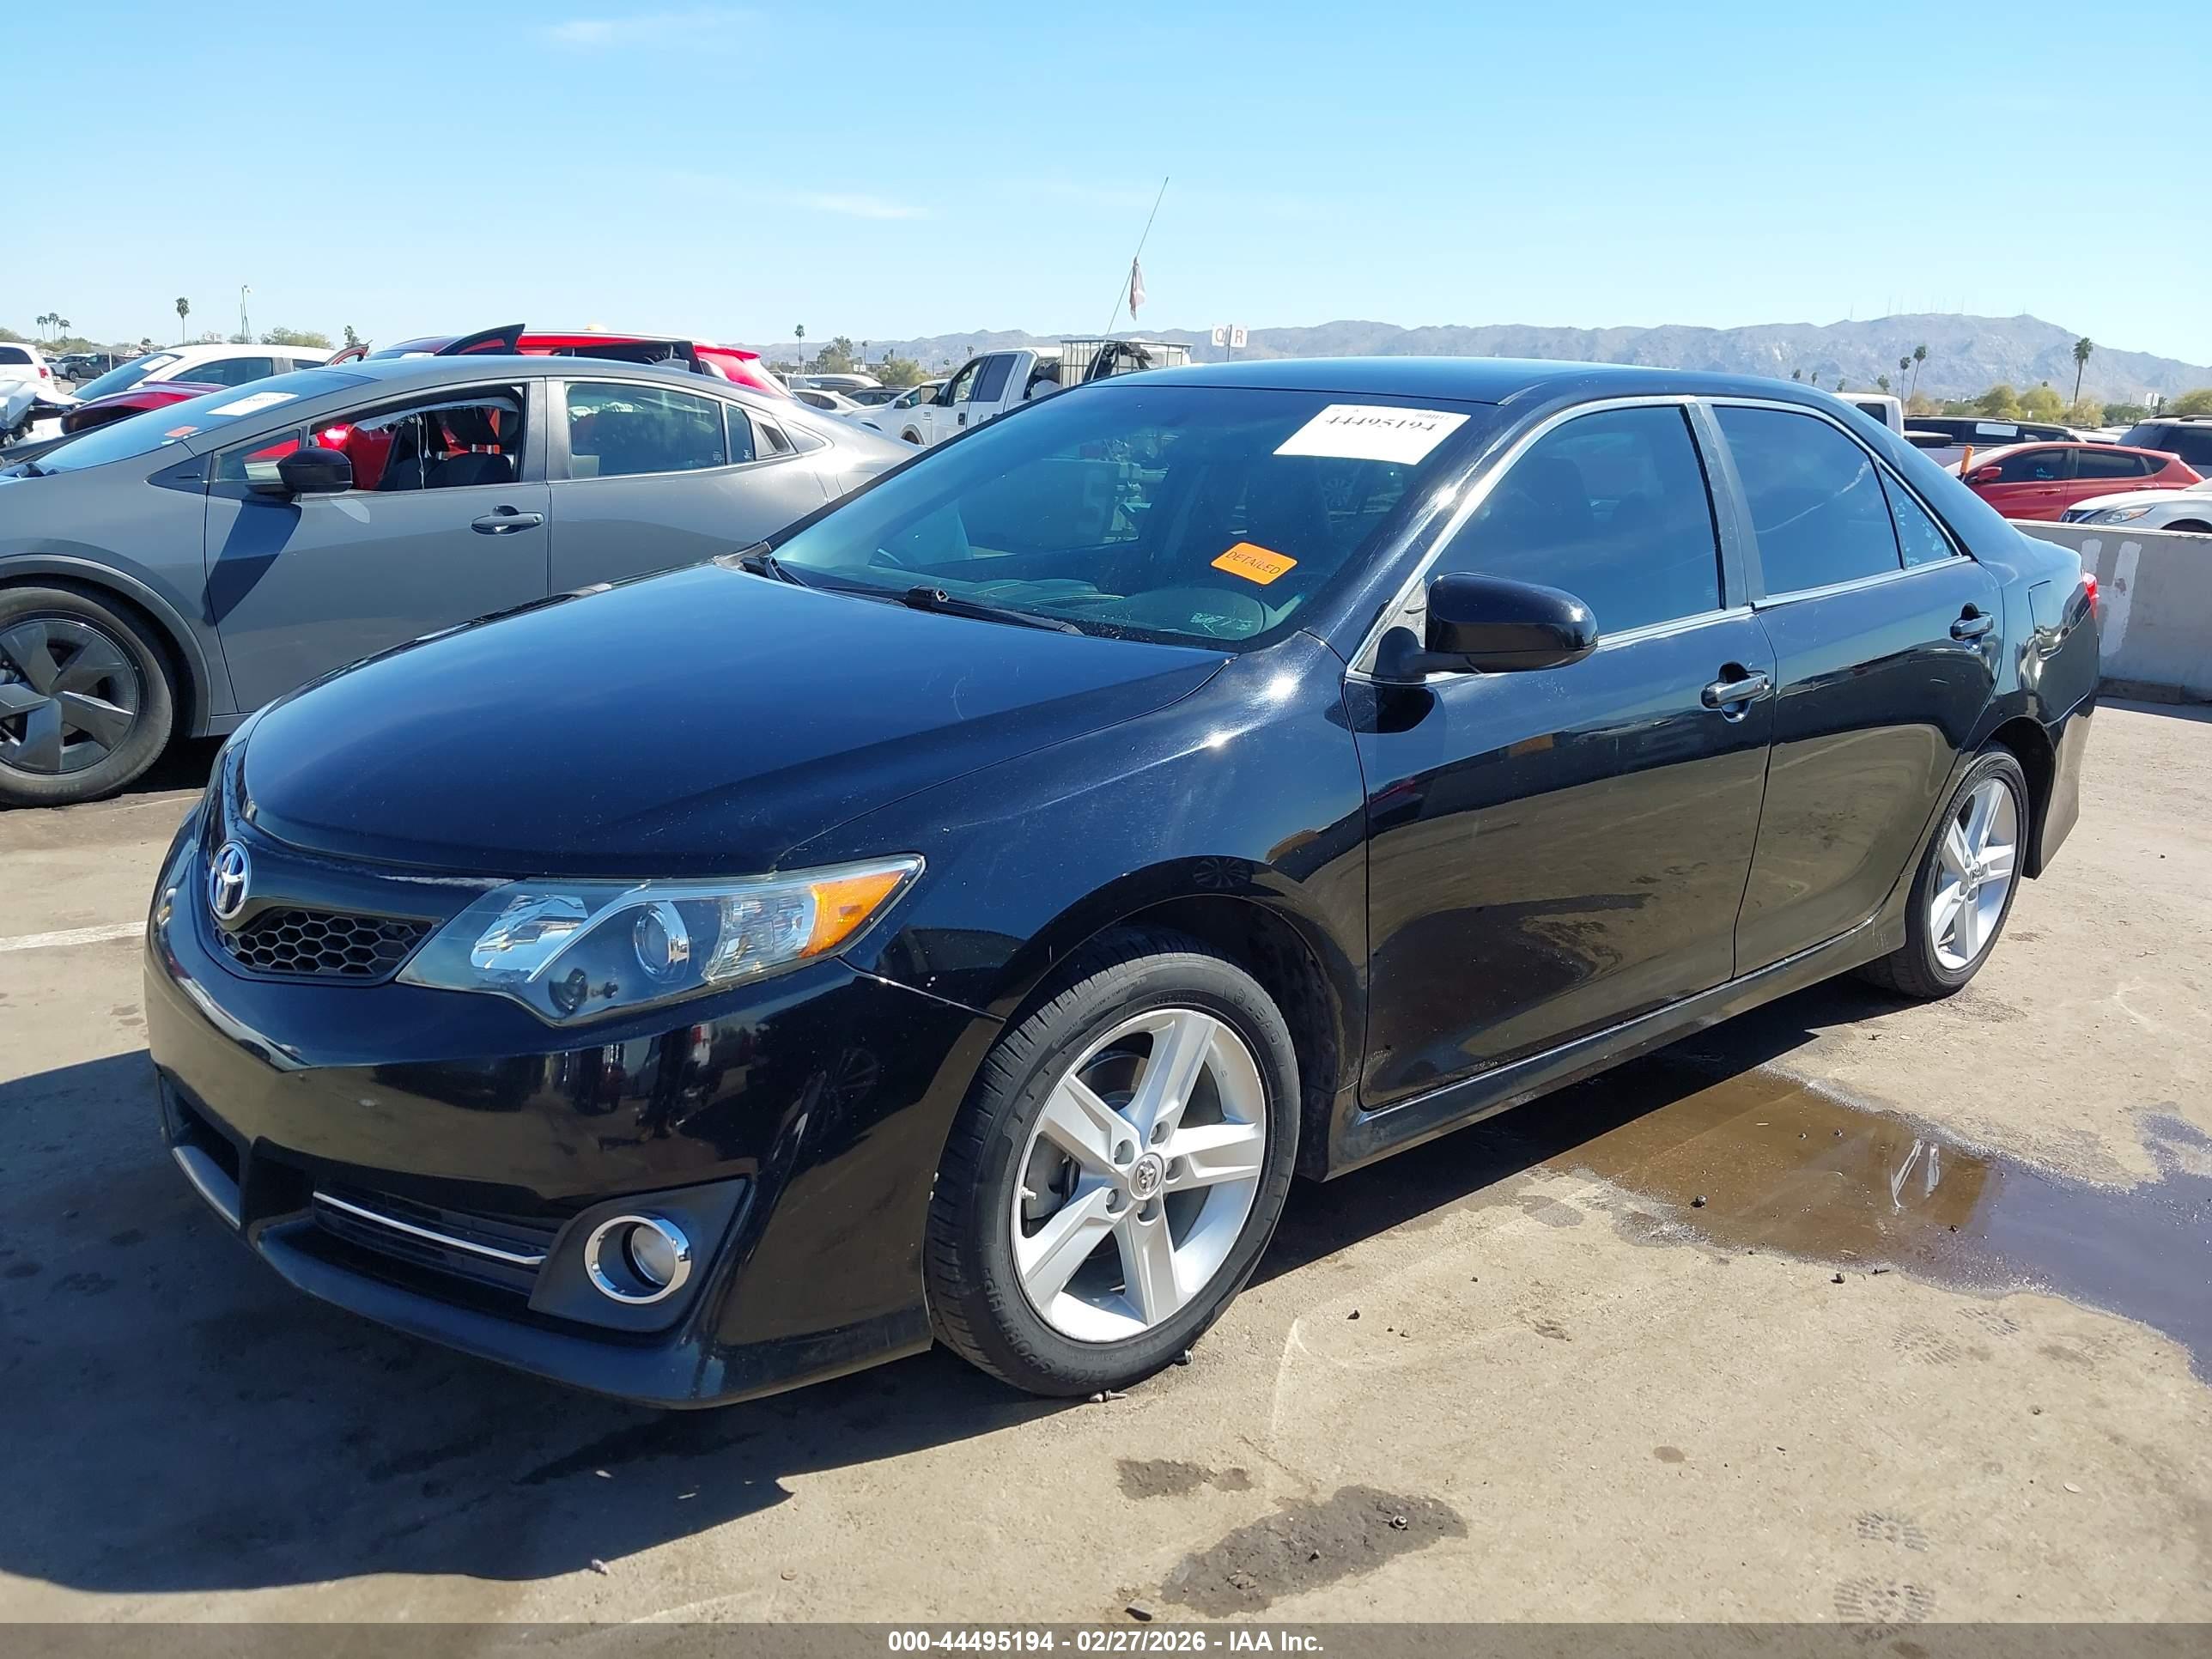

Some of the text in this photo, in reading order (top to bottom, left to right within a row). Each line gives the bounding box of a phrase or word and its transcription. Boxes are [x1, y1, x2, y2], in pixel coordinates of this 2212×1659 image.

[1215, 328, 1243, 343] Q R
[1325, 416, 1438, 432] 44495194
[1224, 550, 1281, 574] DETAILED
[996, 1317, 1056, 1374] SPORT
